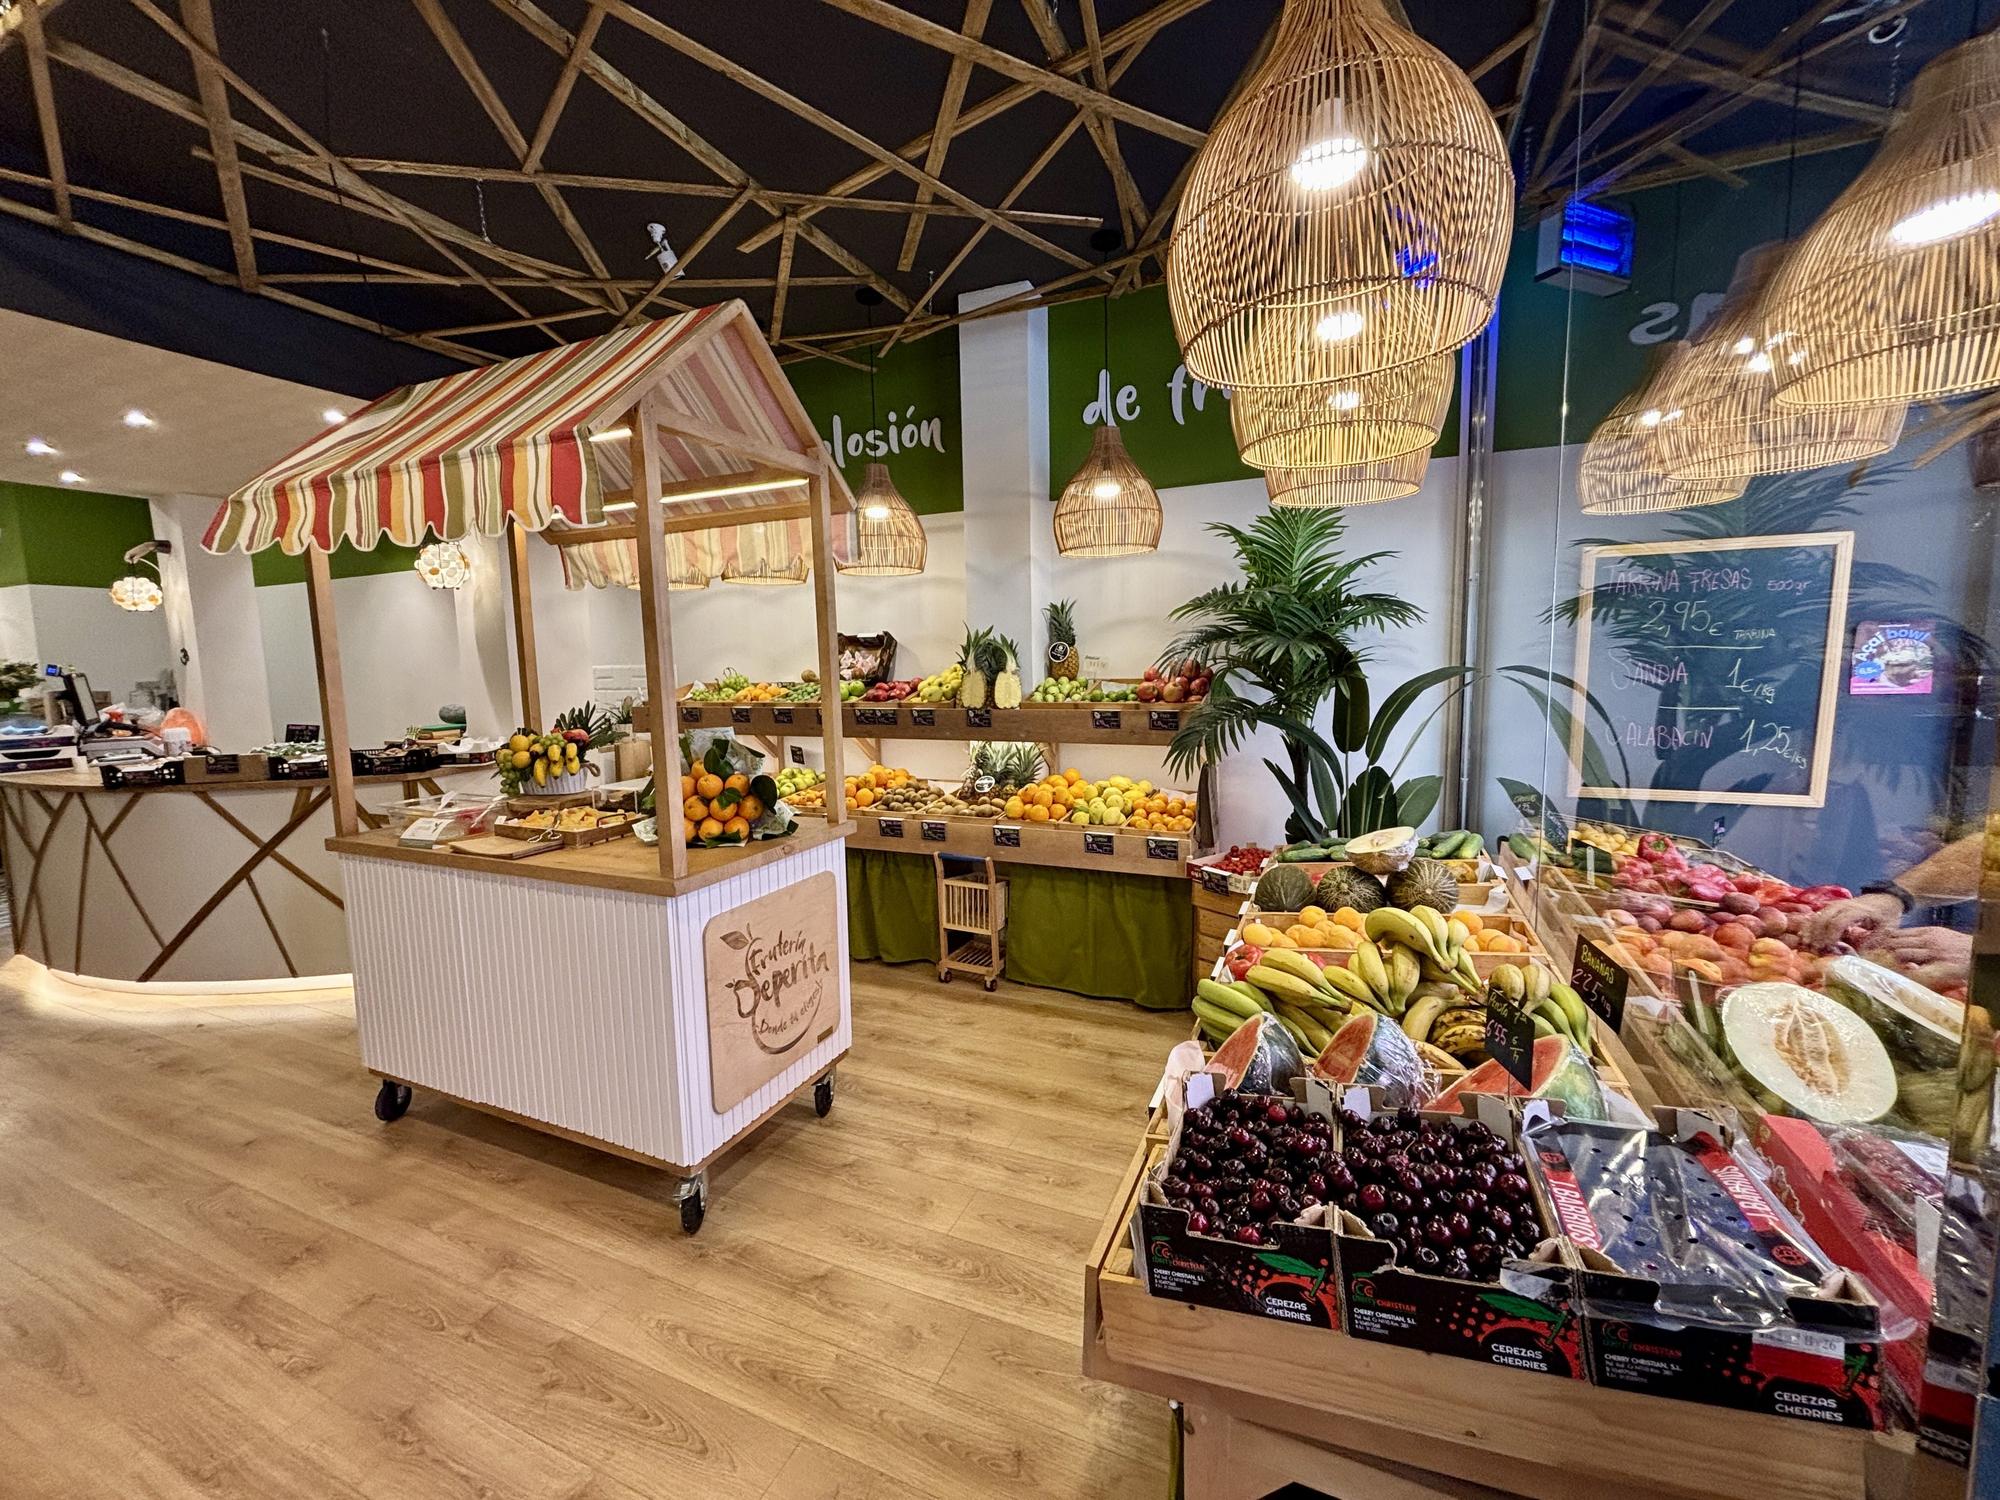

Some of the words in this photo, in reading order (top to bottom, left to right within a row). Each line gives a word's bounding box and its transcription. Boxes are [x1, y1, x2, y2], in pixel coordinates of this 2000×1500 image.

[1082, 368, 1141, 427] de
[1886, 628, 1931, 641] bowl
[1581, 944, 1616, 986] BANANAS
[1265, 1296, 1308, 1311] CEREZAS
[1376, 1299, 1417, 1313] CHRISTIAN
[1266, 1307, 1312, 1322] CHERRIES
[1491, 1343, 1543, 1360] CEREZAS
[1492, 1354, 1548, 1371] CHERRIES
[1774, 1391, 1838, 1408] CEREZAS
[1775, 1403, 1844, 1422] CHERRIES
